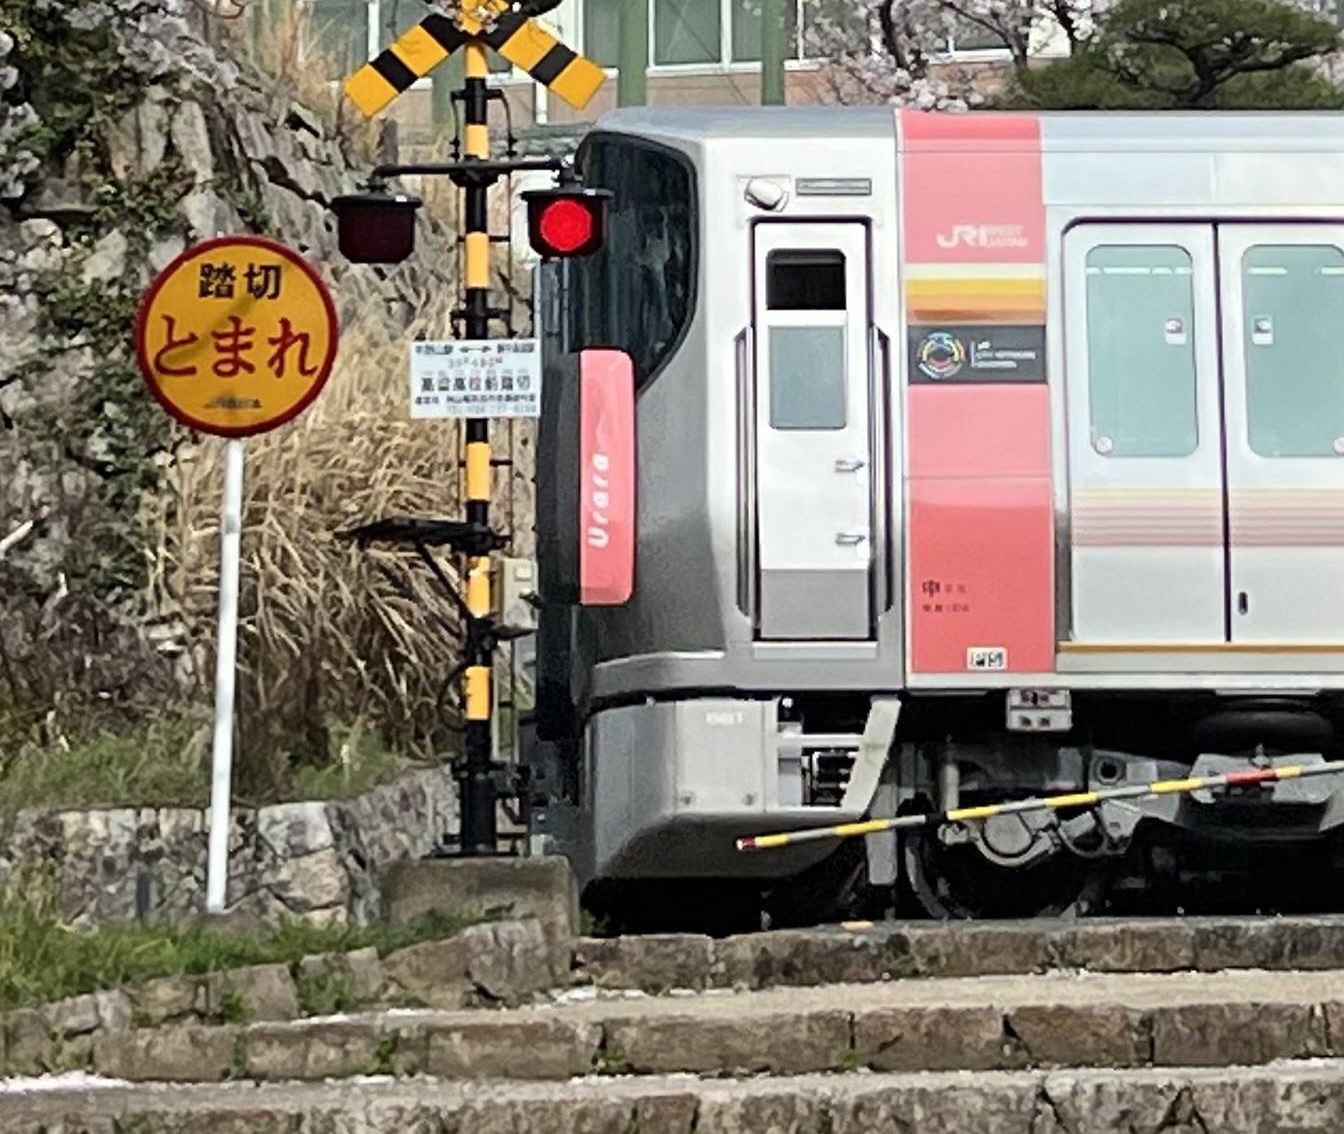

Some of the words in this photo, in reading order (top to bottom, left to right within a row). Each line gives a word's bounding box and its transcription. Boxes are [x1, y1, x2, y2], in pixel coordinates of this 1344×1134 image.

[936, 225, 977, 248] JR
[198, 261, 283, 300] 踏切
[154, 313, 318, 379] とまれ
[587, 452, 609, 548] Urara
